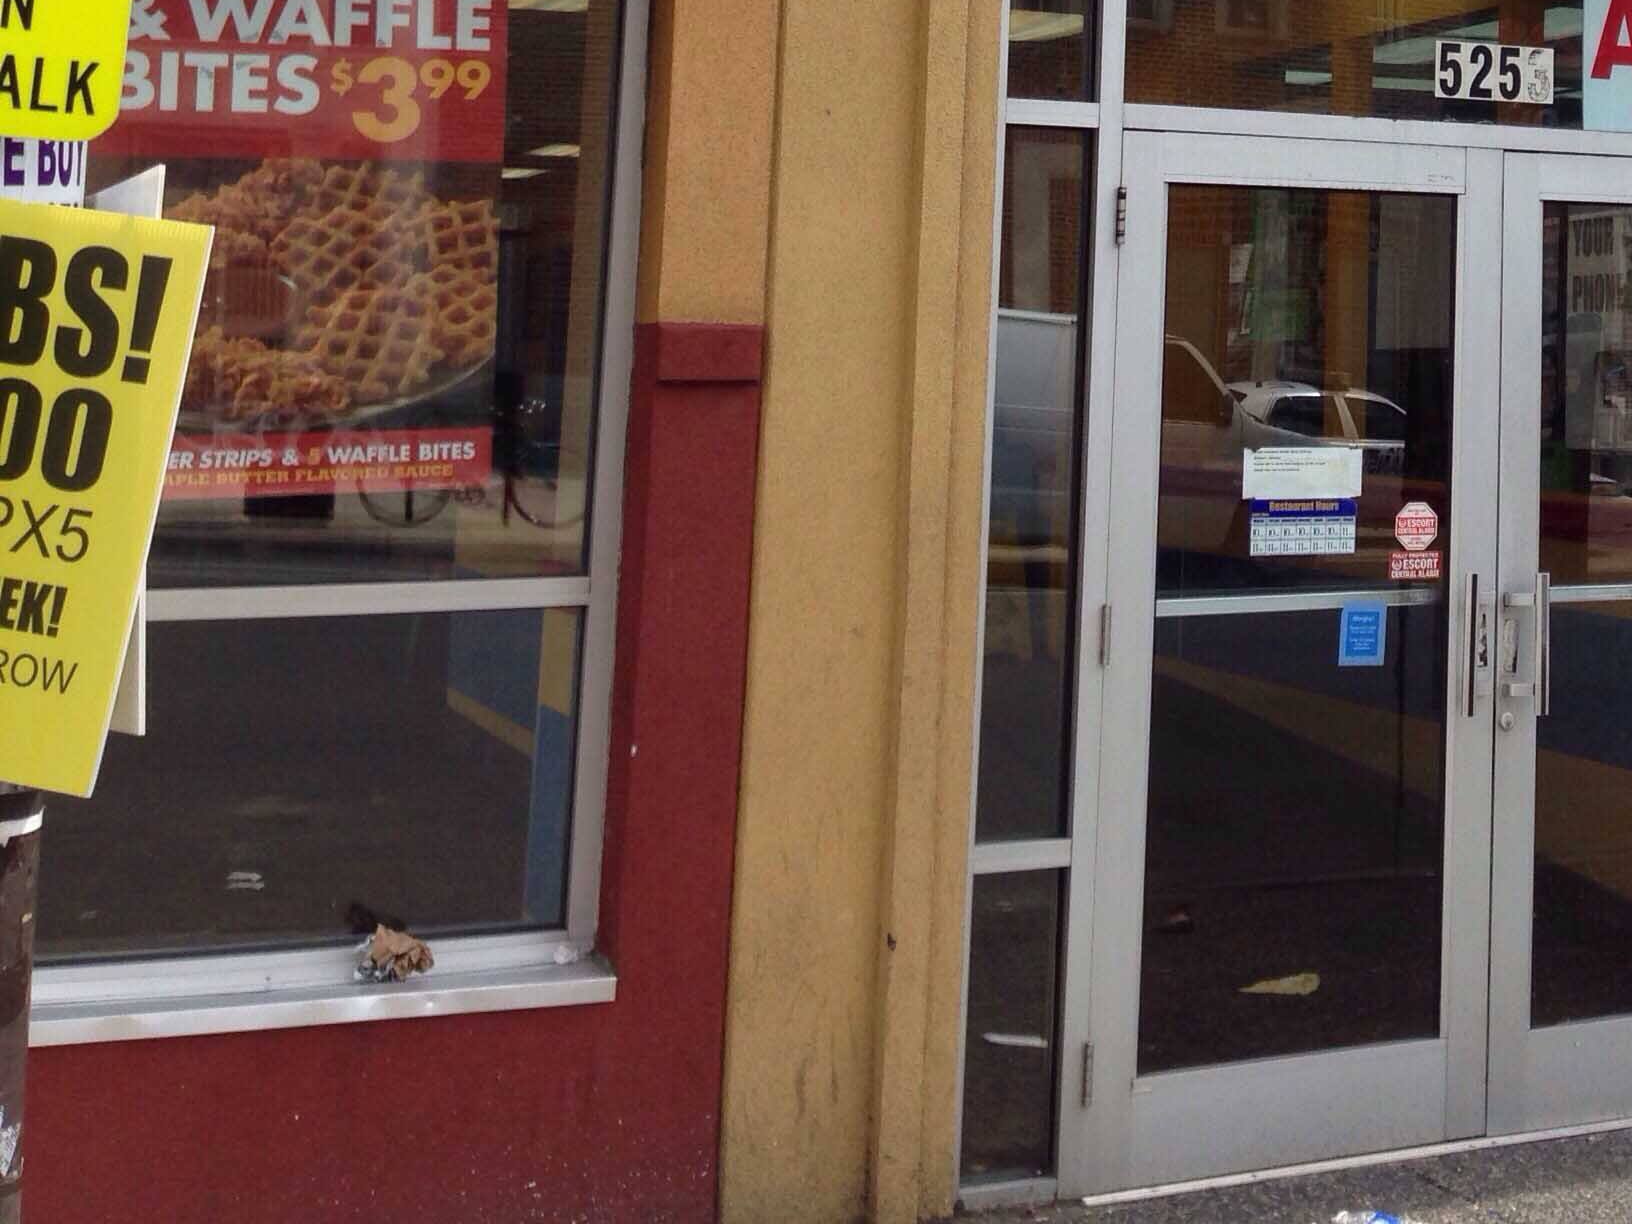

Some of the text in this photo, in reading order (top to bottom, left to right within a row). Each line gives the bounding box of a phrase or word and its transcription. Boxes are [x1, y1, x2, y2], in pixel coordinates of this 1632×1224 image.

[119, 51, 321, 115] BITES
[200, 448, 273, 469] STRIPS
[282, 447, 299, 467] &
[328, 443, 411, 465] WAFFLE
[419, 440, 476, 461] BITES
[1403, 558, 1440, 570] ESCORT
